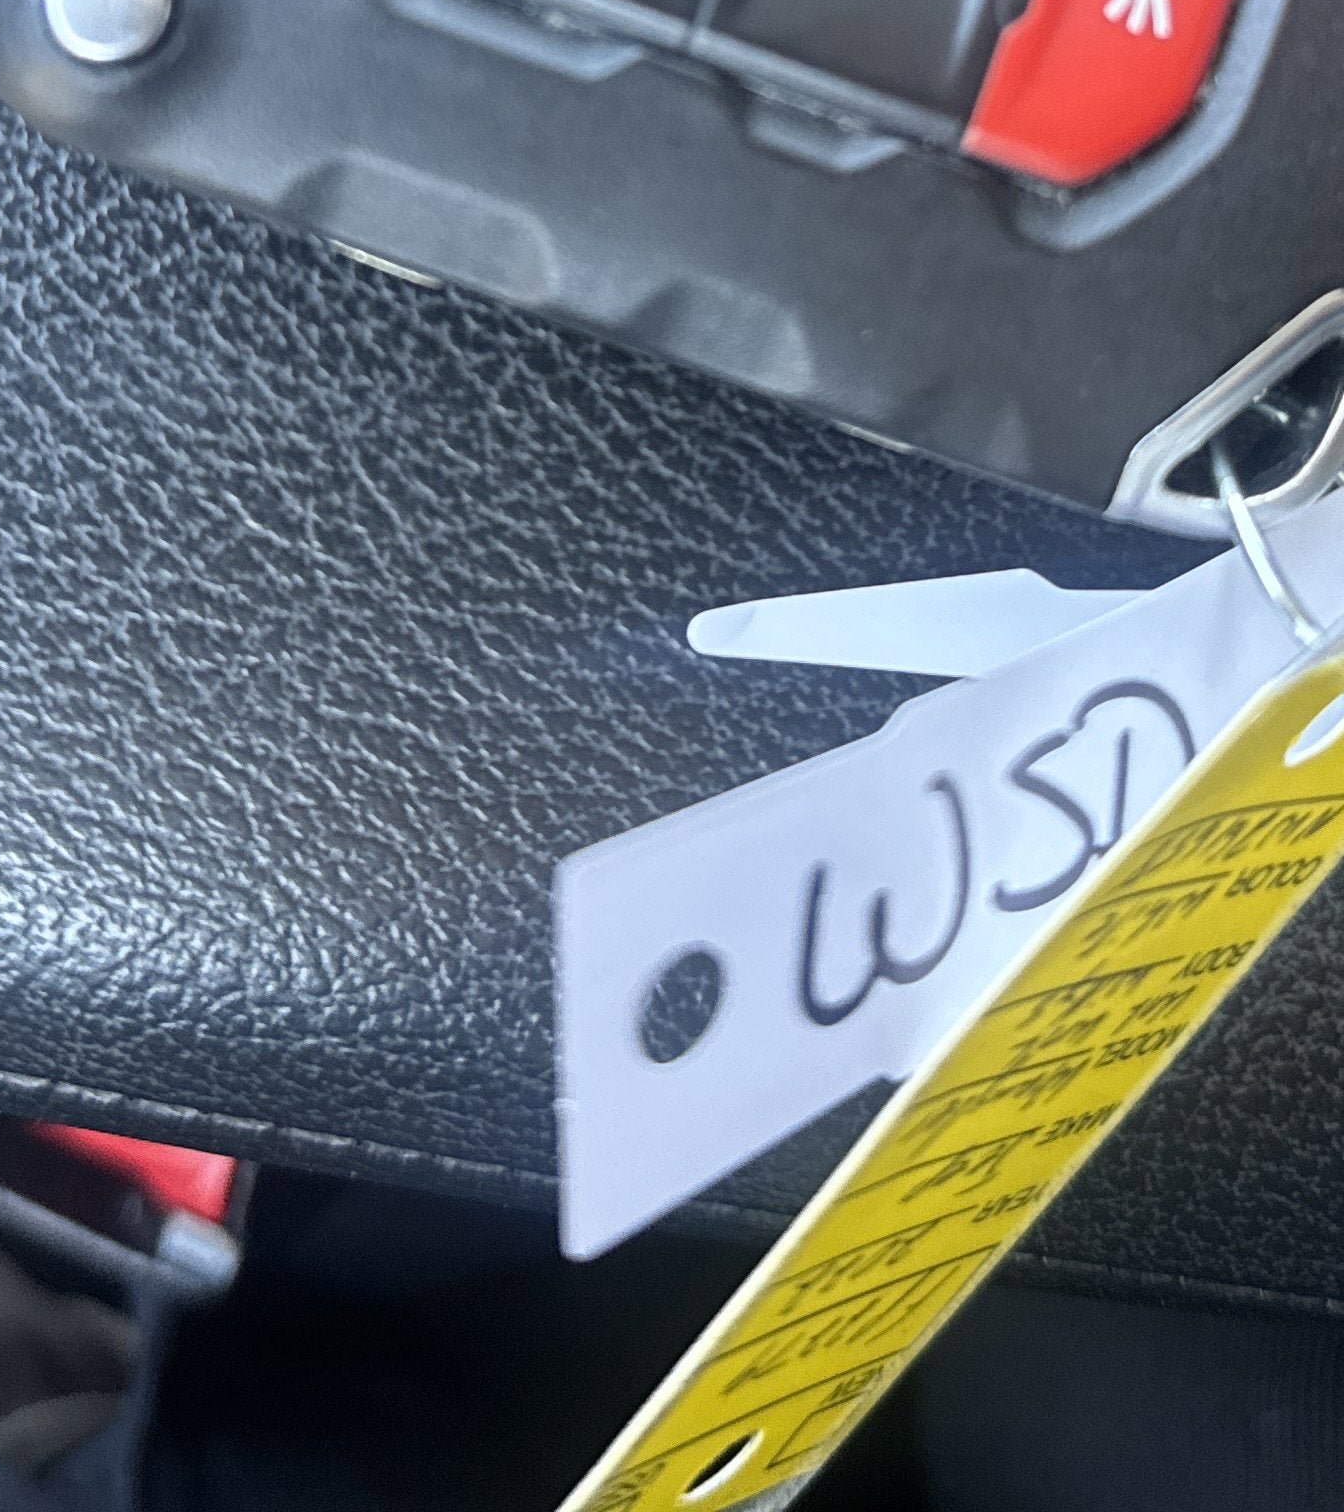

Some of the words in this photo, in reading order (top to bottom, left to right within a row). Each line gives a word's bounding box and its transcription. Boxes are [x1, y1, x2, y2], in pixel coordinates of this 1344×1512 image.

[1222, 854, 1324, 898] COLOR
[1170, 939, 1256, 983] BODY
[1093, 1022, 1190, 1070] MODEL
[1032, 1101, 1122, 1147] MAKE
[970, 1182, 1046, 1223] YEAR
